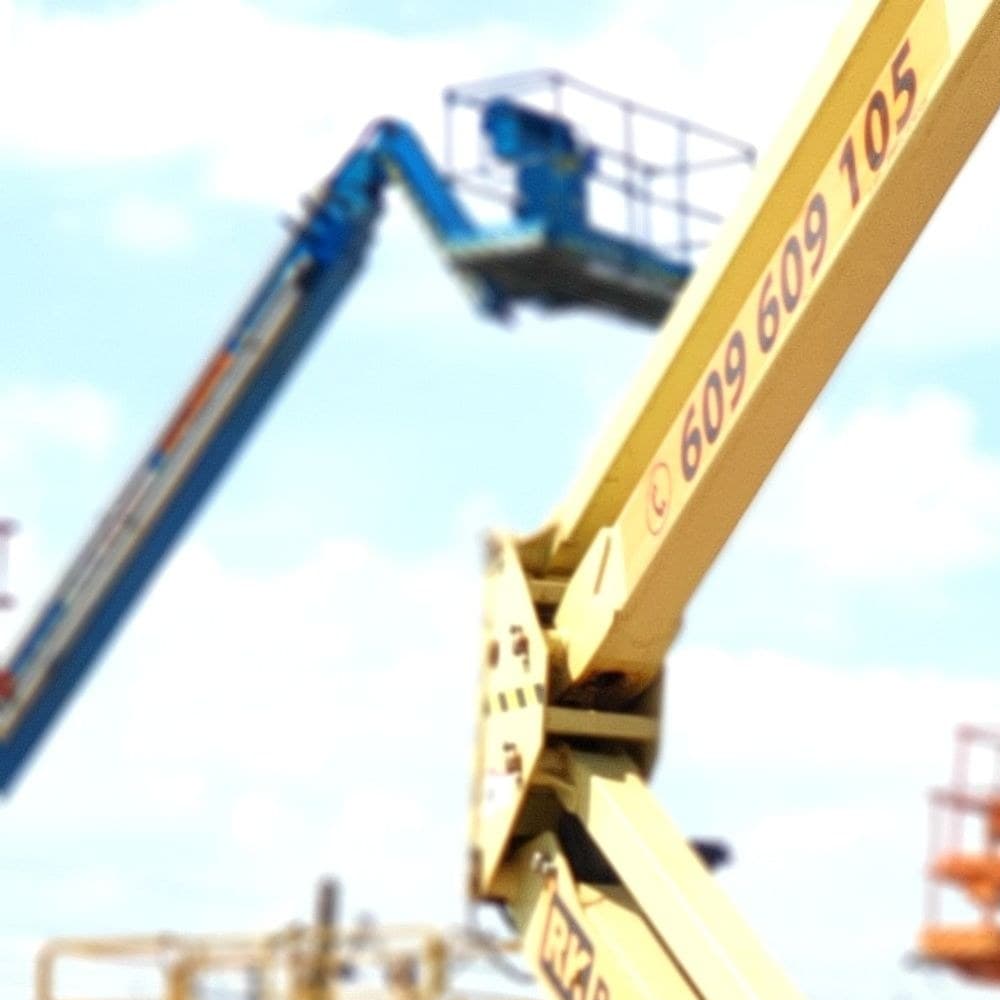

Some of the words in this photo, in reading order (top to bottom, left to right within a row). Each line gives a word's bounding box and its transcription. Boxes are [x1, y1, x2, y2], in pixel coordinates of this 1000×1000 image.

[680, 330, 747, 483] 609
[757, 193, 829, 355] 609
[838, 37, 918, 210] 105
